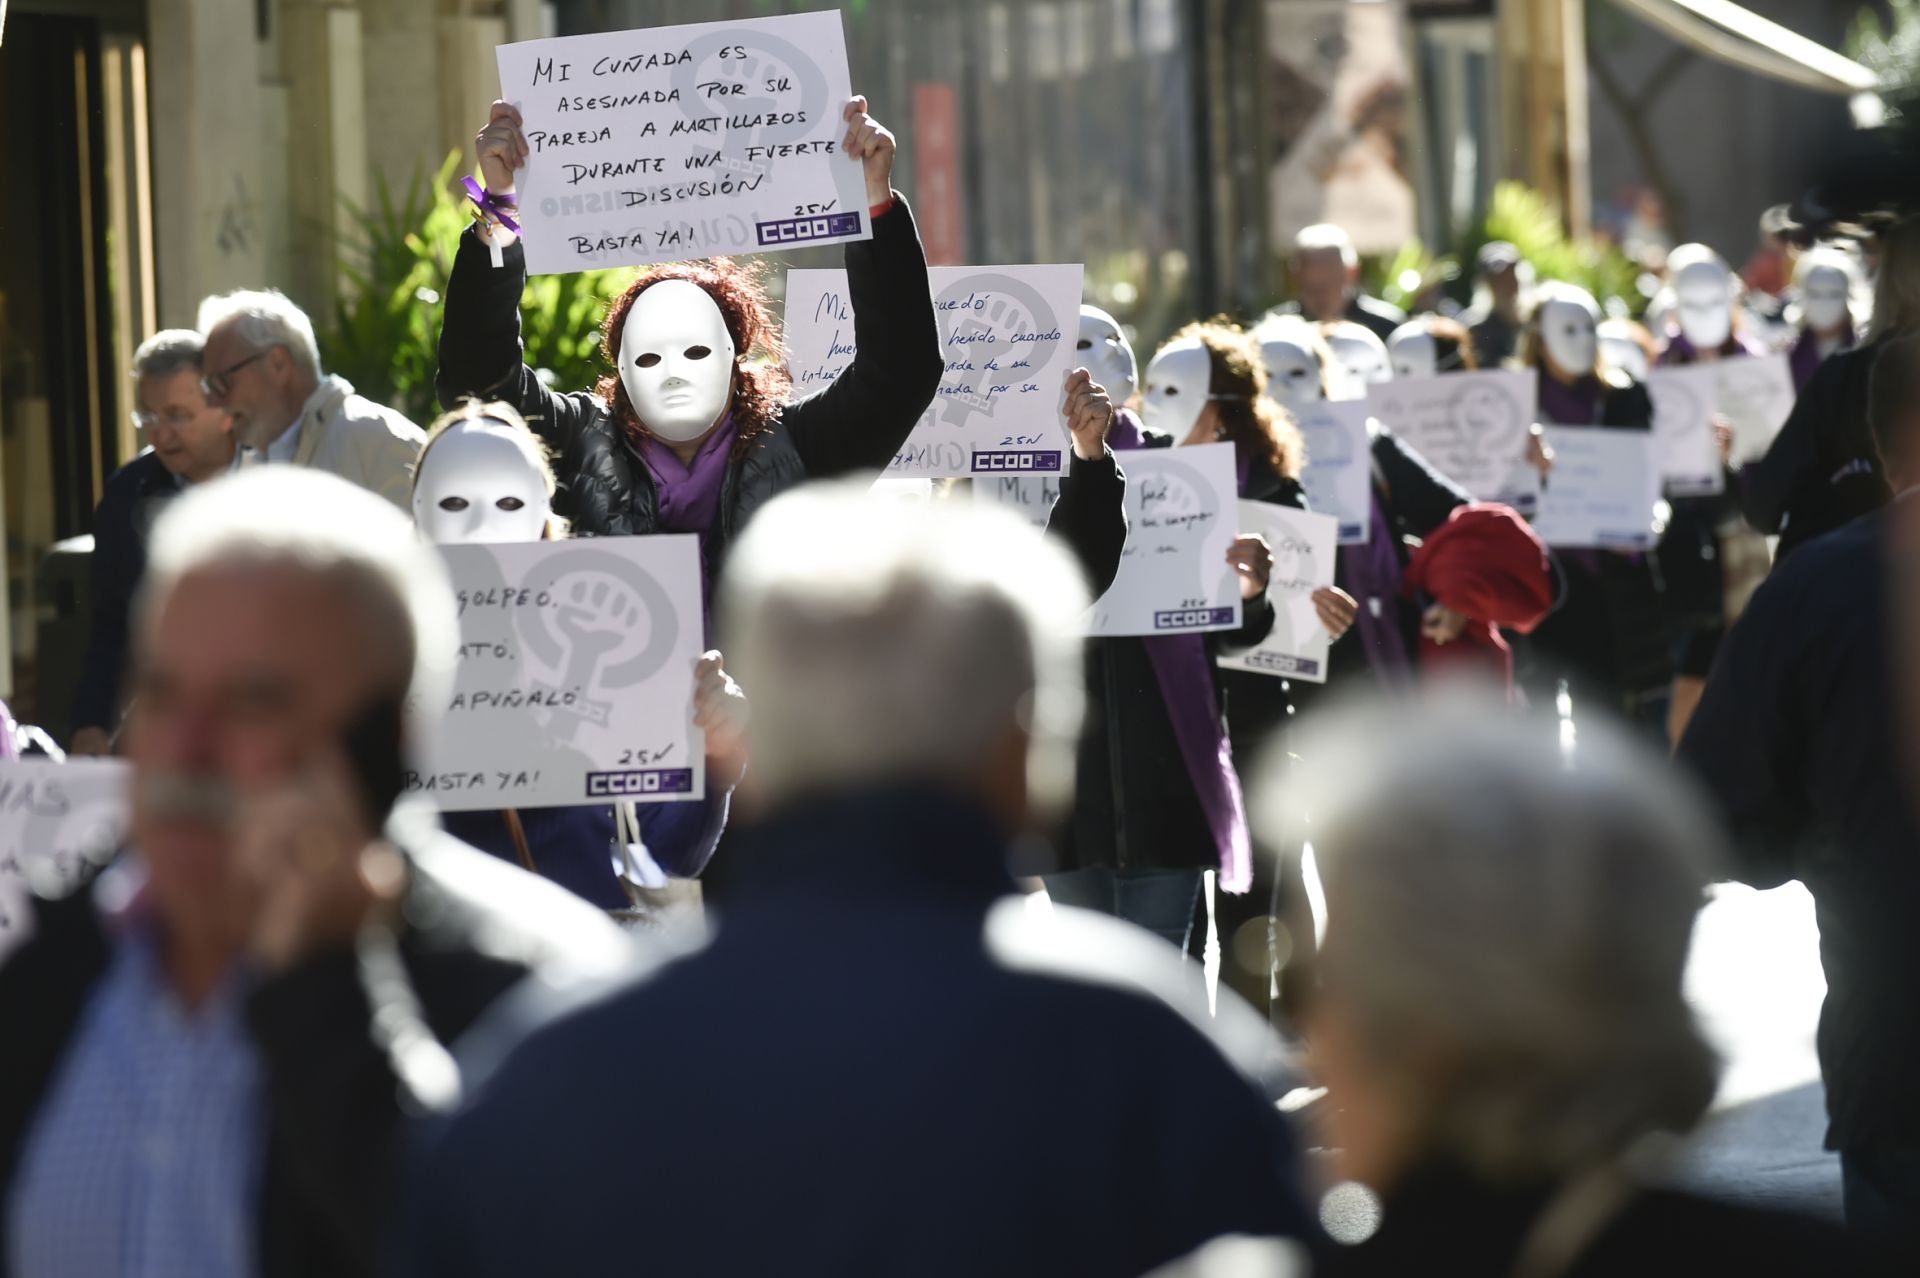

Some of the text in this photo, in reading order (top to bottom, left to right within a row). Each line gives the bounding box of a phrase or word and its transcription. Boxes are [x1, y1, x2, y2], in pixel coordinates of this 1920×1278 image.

[533, 46, 747, 86] MI CUÑADA ES
[558, 78, 792, 112] ASESINADA POR SU
[528, 112, 807, 152] PAREJA A MARTILLAZOS
[562, 141, 836, 185] DURANTE UNA FUERTE
[621, 174, 763, 206] DISCUSIÓN
[794, 199, 837, 215] 25N
[759, 217, 831, 243] CCOO
[568, 234, 642, 253] BASTA
[815, 292, 990, 323] Mi uedó
[1011, 328, 1061, 343] cuando
[984, 359, 999, 370] de
[1011, 360, 1030, 368] su
[985, 385, 1010, 400] por
[1020, 384, 1039, 393] su
[1000, 433, 1043, 445] 25N
[974, 453, 1034, 470] CCOO
[1156, 610, 1211, 628] CCOO
[400, 767, 486, 791] BASTA
[589, 772, 660, 794] CCOO
